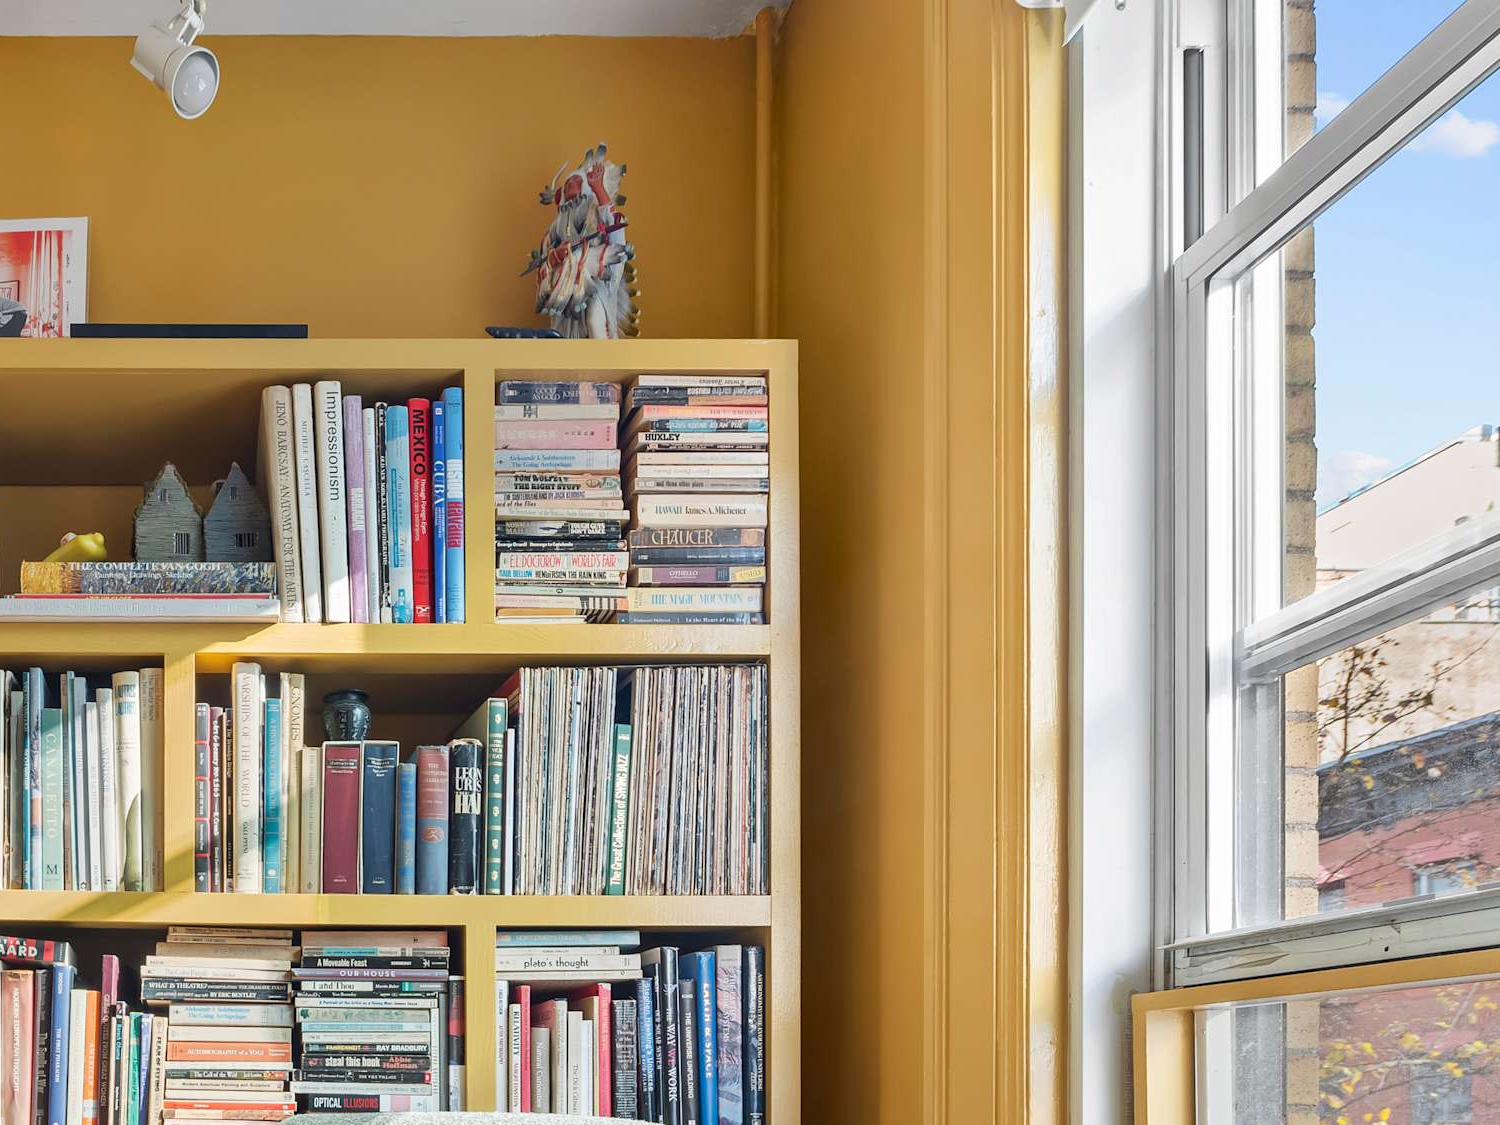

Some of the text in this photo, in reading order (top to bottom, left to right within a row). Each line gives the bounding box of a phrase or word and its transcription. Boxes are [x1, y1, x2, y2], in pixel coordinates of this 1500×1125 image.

[412, 409, 427, 476] MEXICO
[645, 433, 680, 441] HUXLEY
[324, 391, 343, 501] Impressionism
[433, 460, 445, 505] CUBA
[715, 505, 747, 515] Michener
[651, 528, 713, 545] CHAUCER
[69, 562, 219, 571] THE COMPLETE VAN GOGH
[290, 686, 301, 741] GNOMES
[45, 733, 58, 839] CANALETTO
[317, 959, 367, 967] A Moveable Feast
[523, 956, 588, 969] plato's thought
[339, 970, 396, 978] OUR HOUSE
[376, 1044, 427, 1052] RAY BRADBURY
[324, 1057, 380, 1067] steal this book
[666, 1023, 678, 1103] WAY WE WORK
[686, 1060, 694, 1098] UNFOLDING
[313, 1097, 379, 1108] OPTICAL ILLUSIONS
